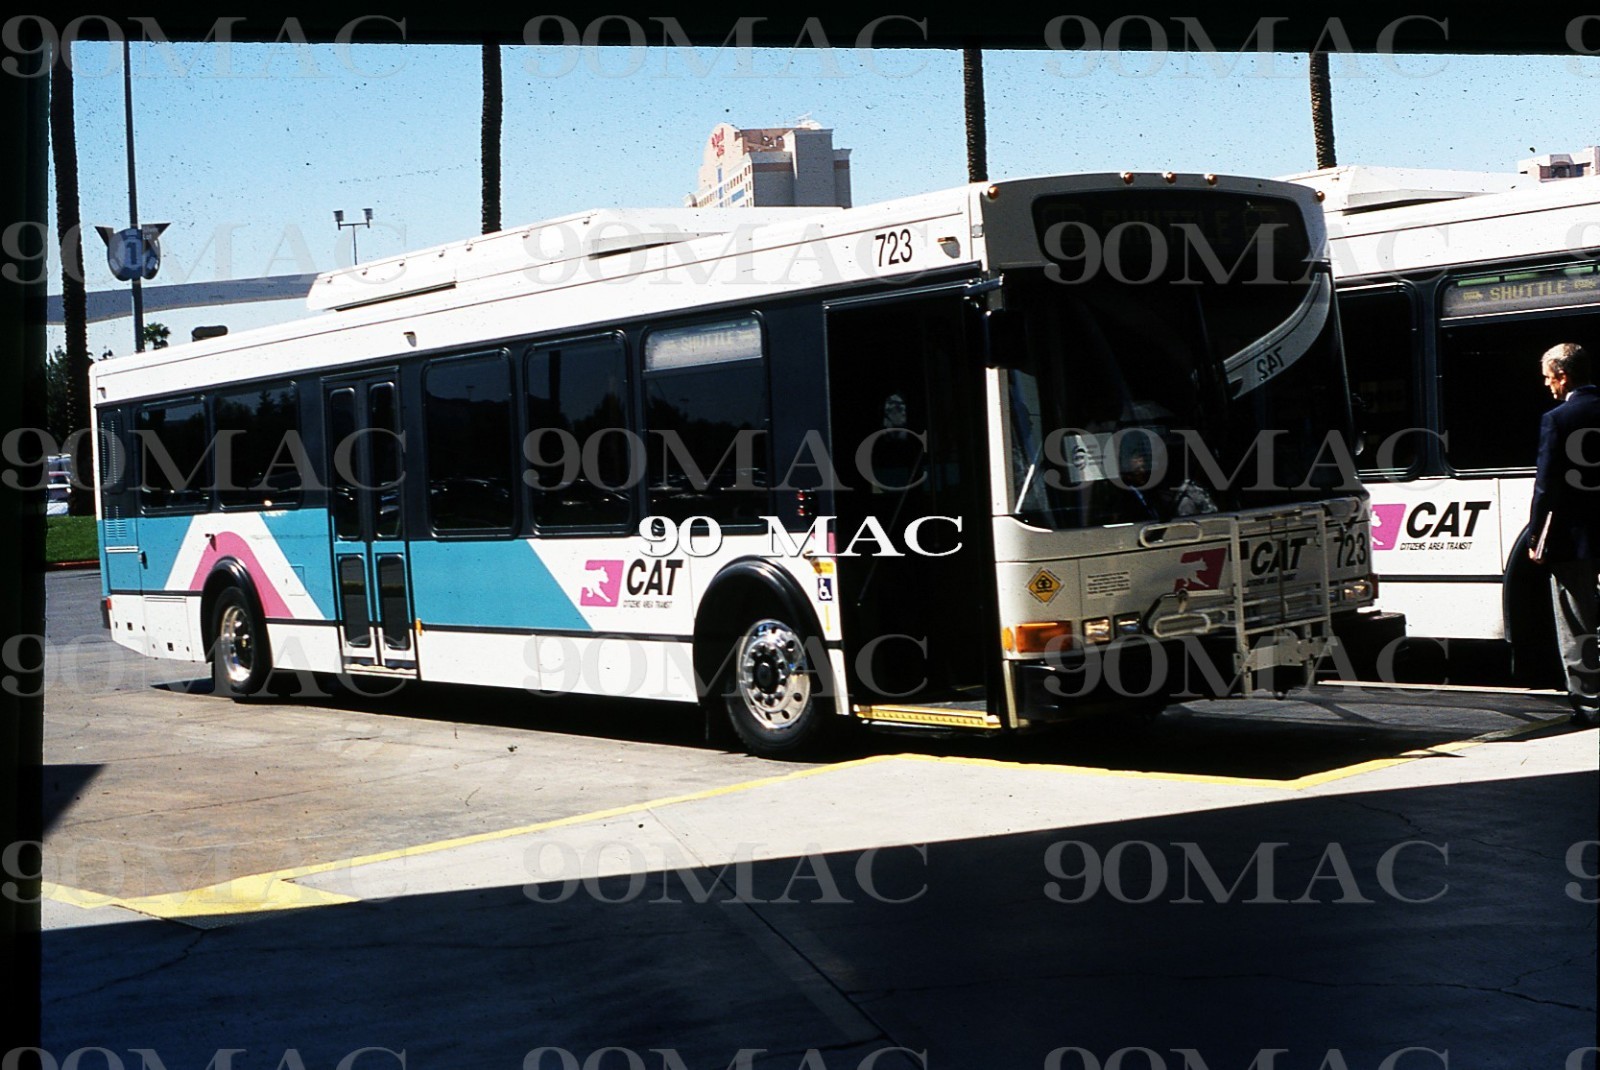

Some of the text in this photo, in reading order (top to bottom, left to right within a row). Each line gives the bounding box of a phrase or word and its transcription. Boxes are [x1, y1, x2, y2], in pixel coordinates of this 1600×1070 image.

[126, 241, 138, 266] 1
[875, 228, 912, 267] 723
[1489, 279, 1568, 301] SHUTTLE
[1406, 500, 1492, 539] CAT
[1250, 536, 1308, 576] CAT
[1333, 531, 1367, 569] 723
[1400, 542, 1473, 551] CITIZENS AREA TRANSIT
[626, 558, 684, 596] CAT
